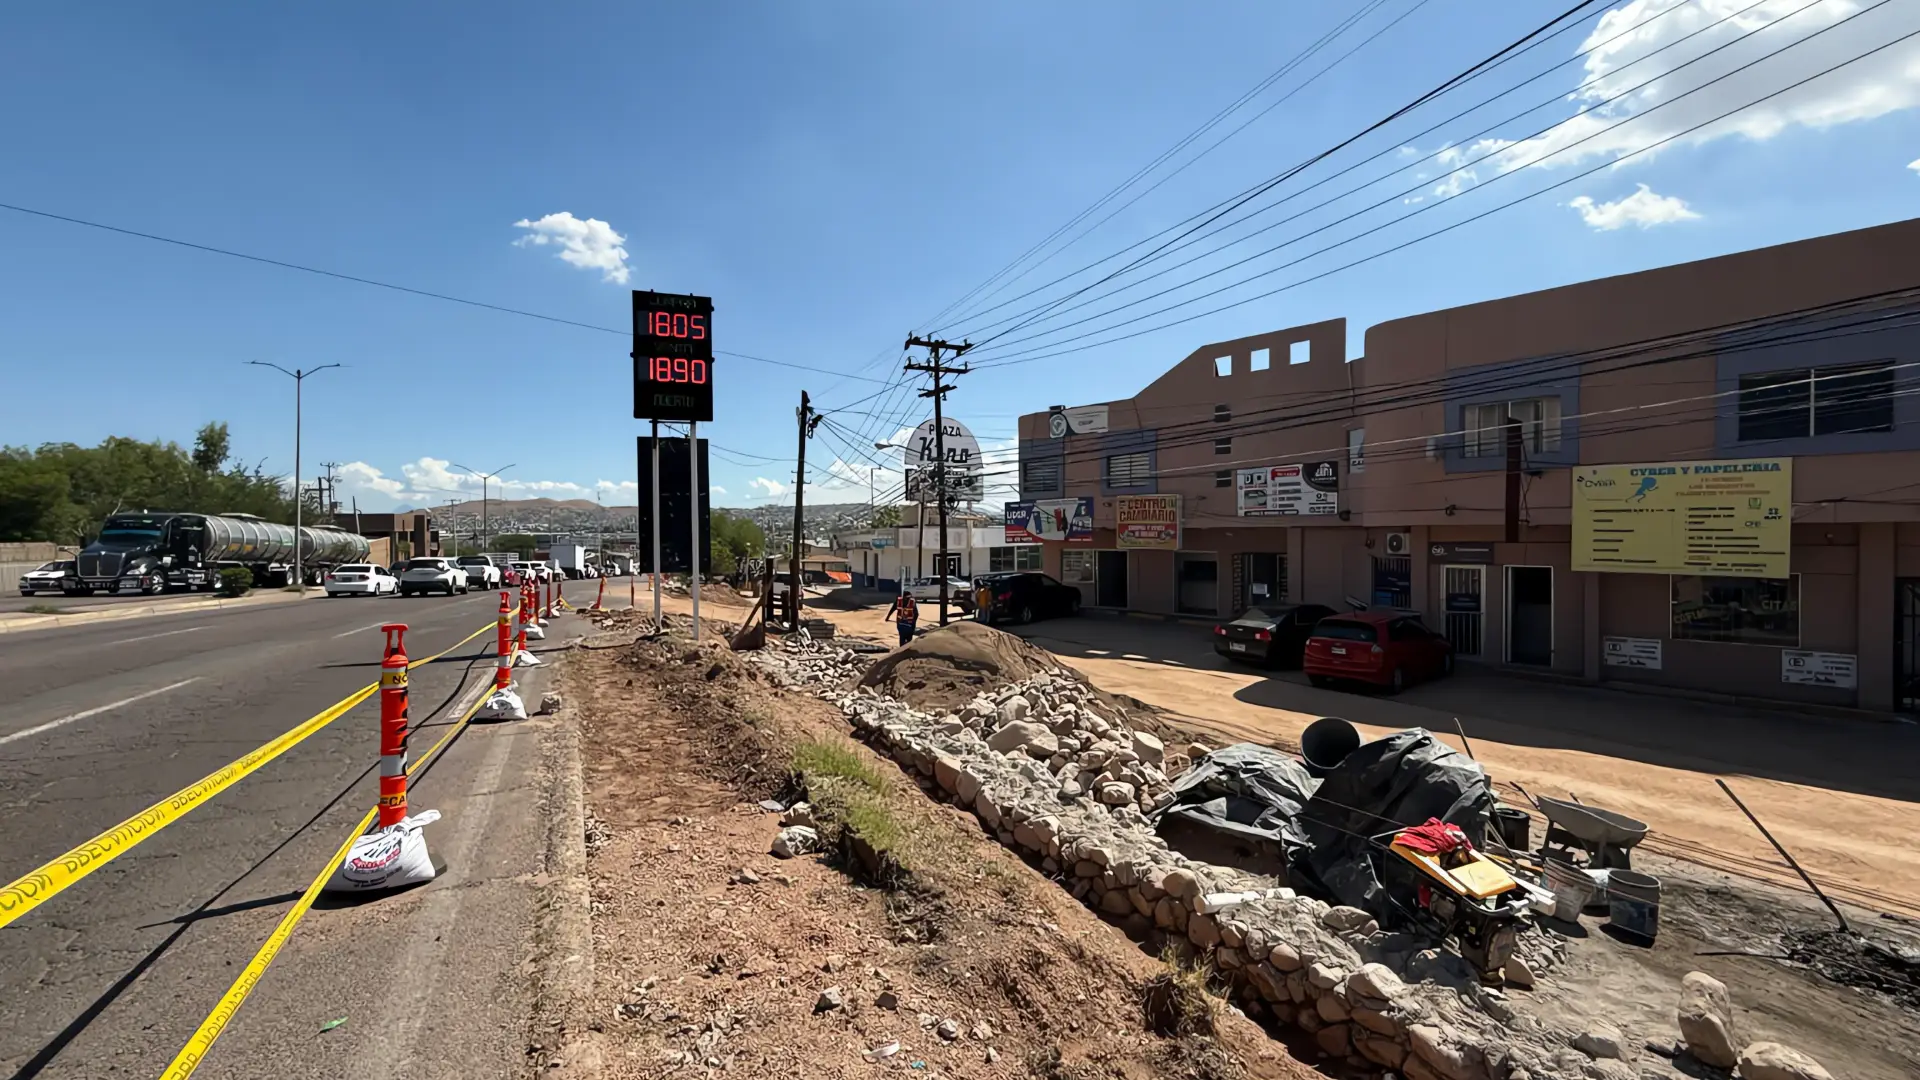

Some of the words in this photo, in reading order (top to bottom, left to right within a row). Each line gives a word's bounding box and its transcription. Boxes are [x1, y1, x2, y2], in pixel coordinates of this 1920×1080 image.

[648, 357, 706, 385] 18.90
[929, 424, 962, 437] PAZA
[1680, 466, 1691, 475] Y
[1128, 499, 1166, 509] CENTRO
